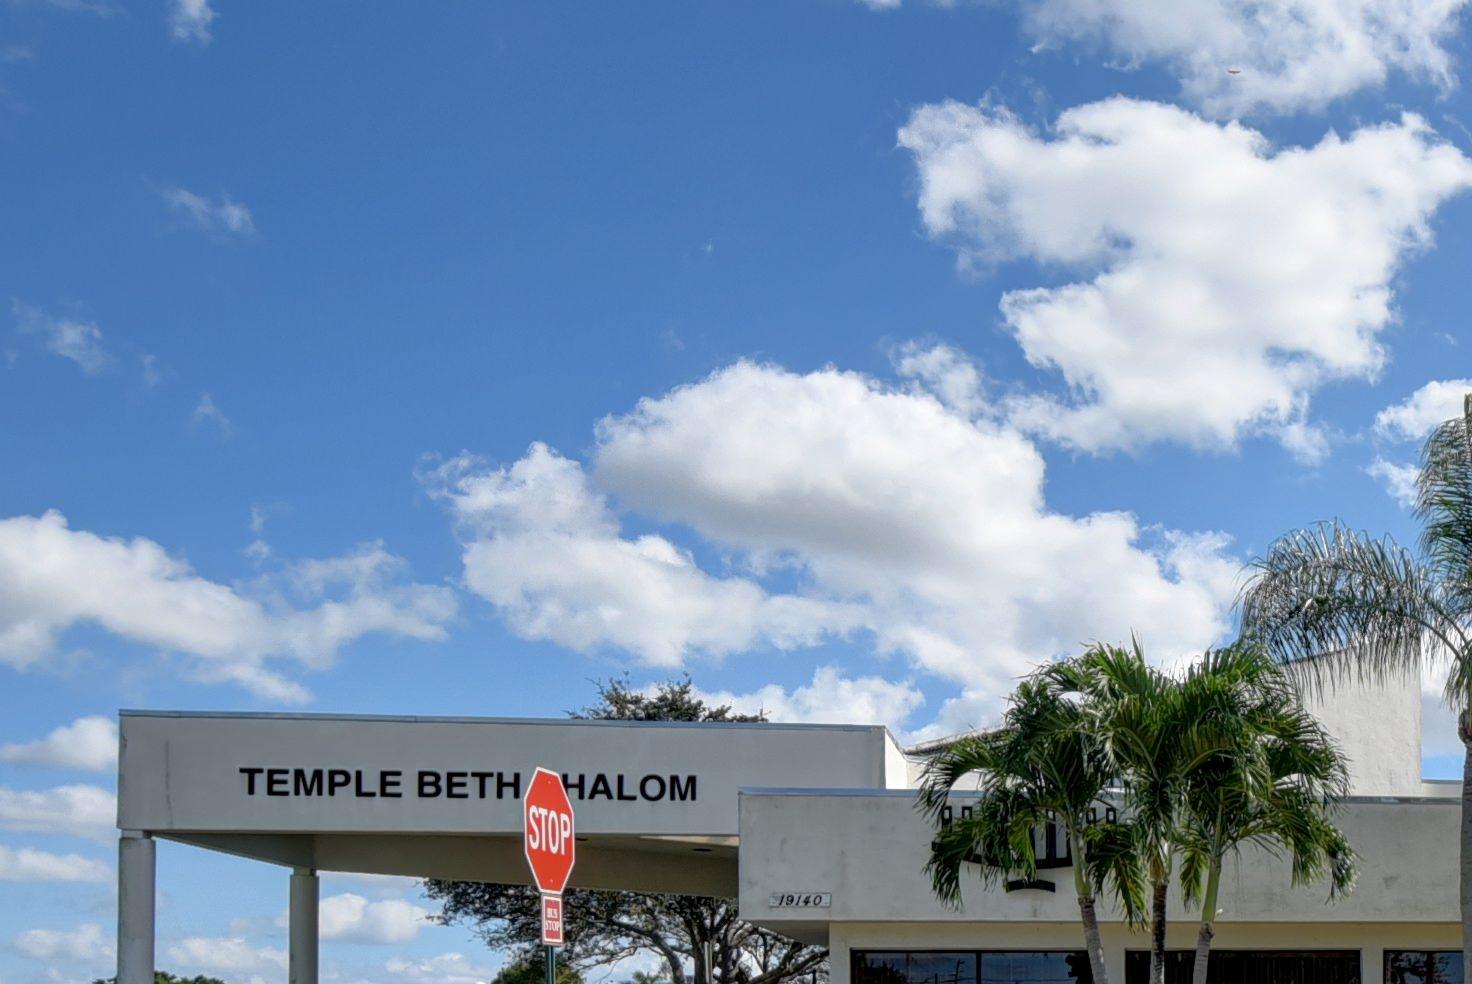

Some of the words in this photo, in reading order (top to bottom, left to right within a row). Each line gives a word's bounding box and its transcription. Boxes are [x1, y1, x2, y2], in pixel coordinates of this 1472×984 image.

[239, 767, 403, 798] TEMPLE
[417, 771, 520, 800] BETH
[562, 773, 698, 802] HALOM
[528, 805, 571, 856] STOP
[779, 894, 823, 906] 19140
[546, 907, 559, 918] BUS
[545, 920, 560, 931] STOP
